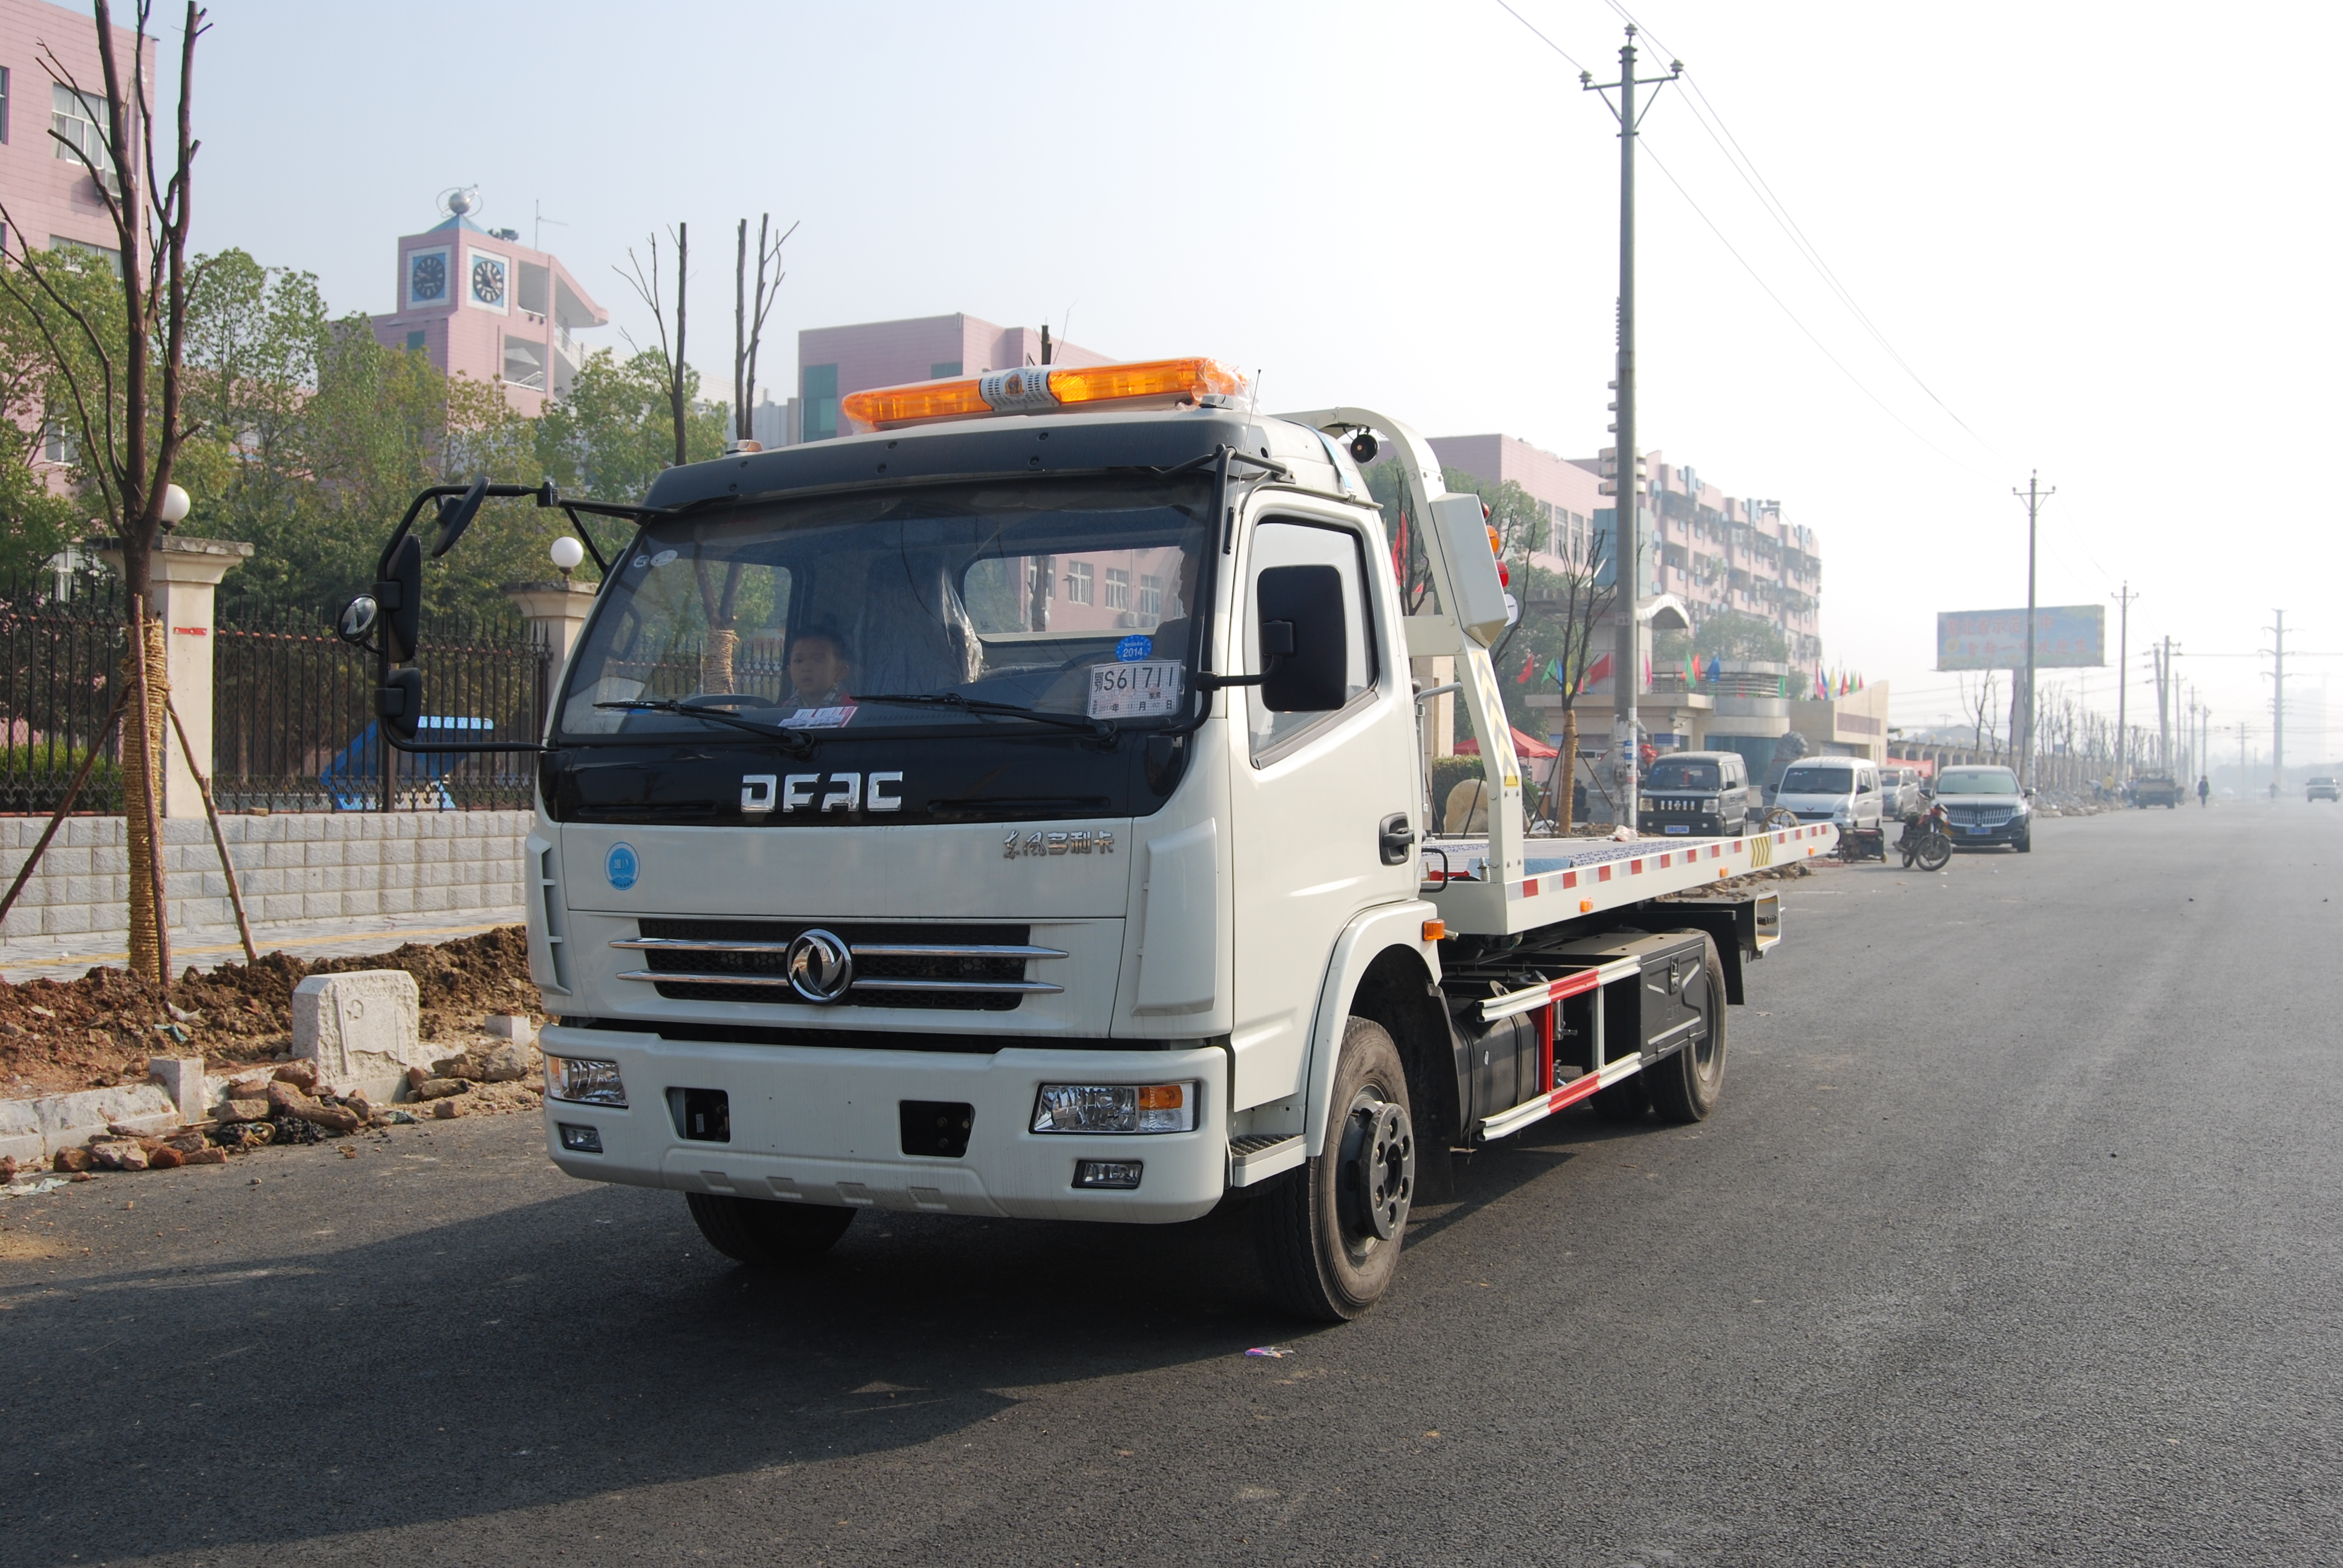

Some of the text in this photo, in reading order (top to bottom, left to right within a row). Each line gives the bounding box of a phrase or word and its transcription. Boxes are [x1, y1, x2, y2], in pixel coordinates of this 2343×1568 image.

[1122, 647, 1143, 658] 2014
[1094, 667, 1173, 692] 鄂S61711
[741, 771, 903, 812] DFAC
